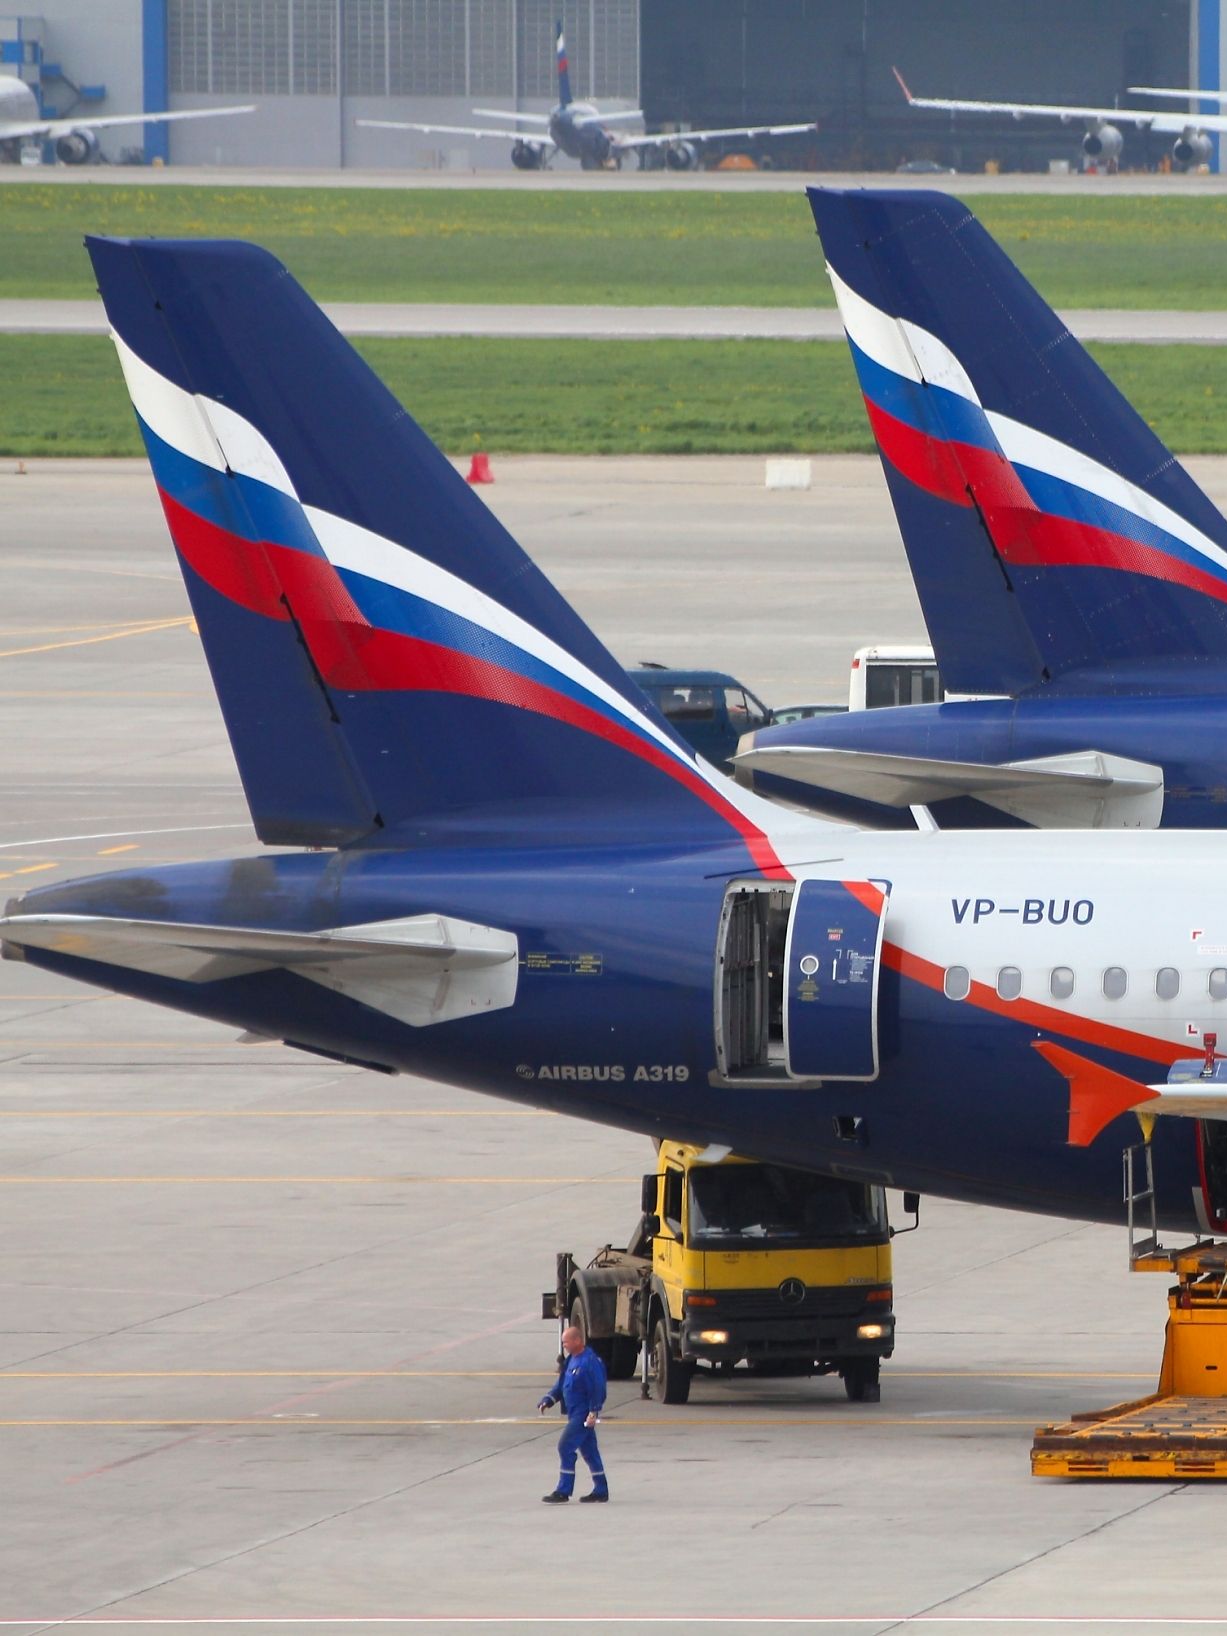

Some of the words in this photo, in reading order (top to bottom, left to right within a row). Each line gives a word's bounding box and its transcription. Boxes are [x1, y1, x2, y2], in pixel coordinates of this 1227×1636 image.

[951, 898, 1094, 926] VP-BUO
[537, 1065, 626, 1082] AIRBUS
[633, 1065, 690, 1082] A319
